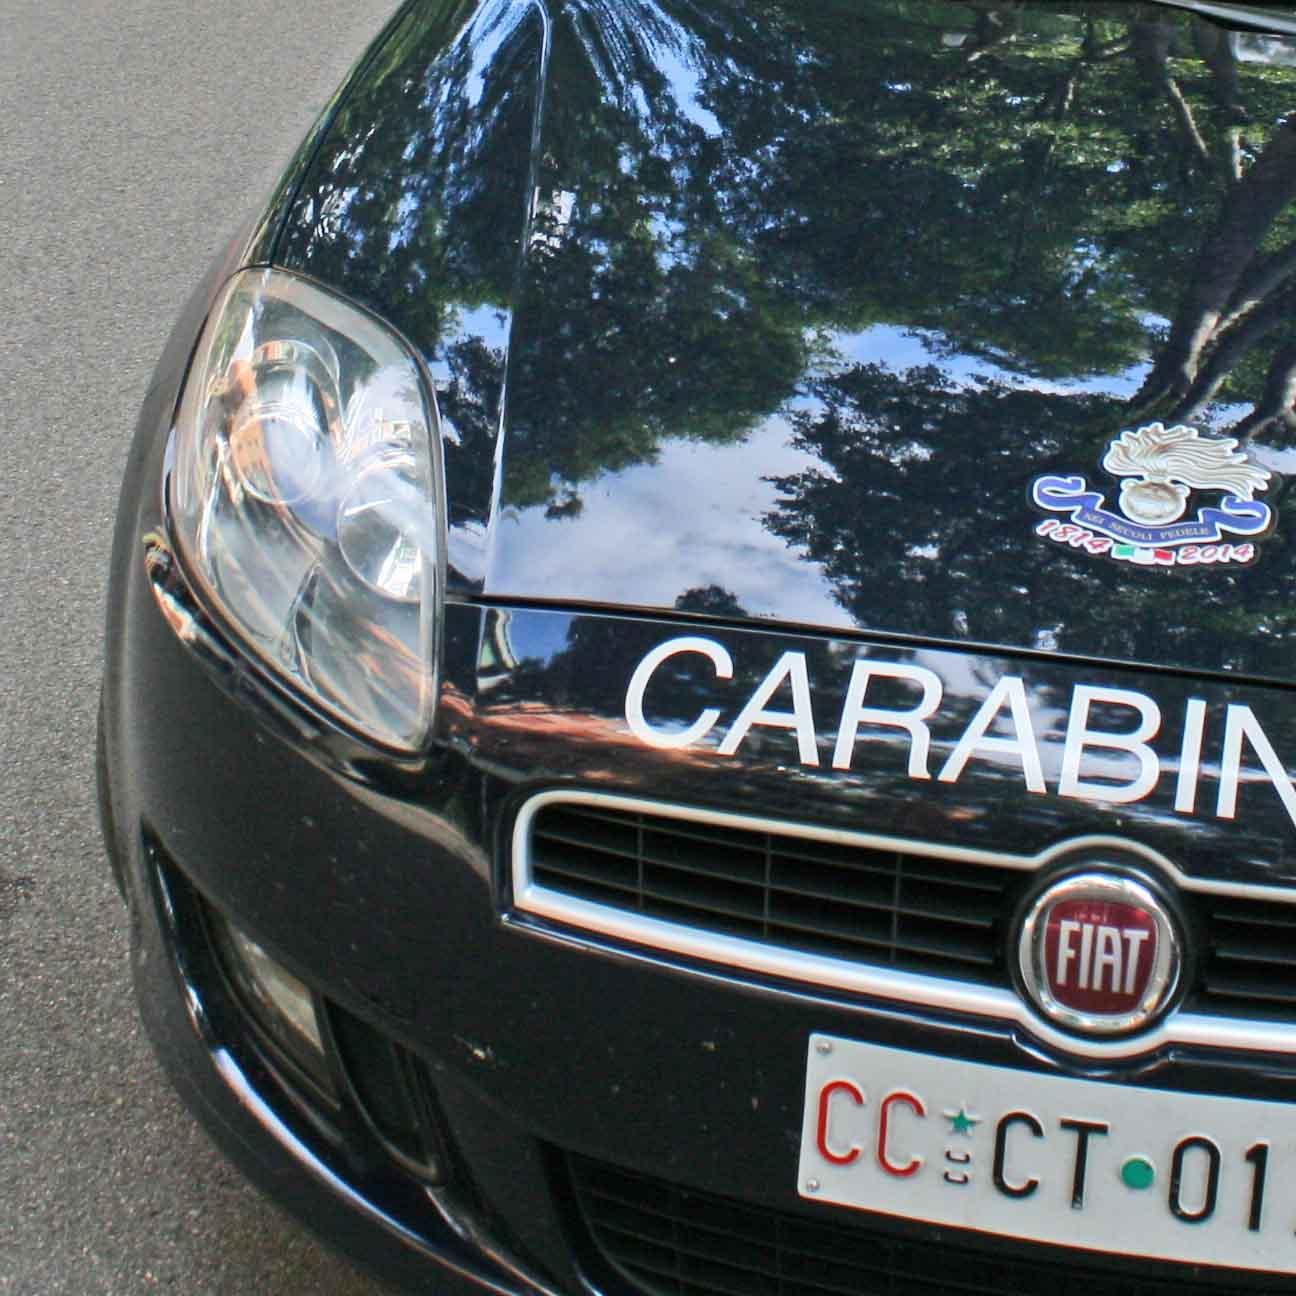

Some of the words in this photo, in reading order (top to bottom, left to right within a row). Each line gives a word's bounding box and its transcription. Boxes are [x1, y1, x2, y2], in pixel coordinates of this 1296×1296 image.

[1036, 520, 1112, 554] 1814
[1178, 544, 1254, 564] 2014
[1056, 919, 1150, 995] FIAT
[817, 1080, 926, 1178] CC
[992, 1111, 1110, 1209] CT
